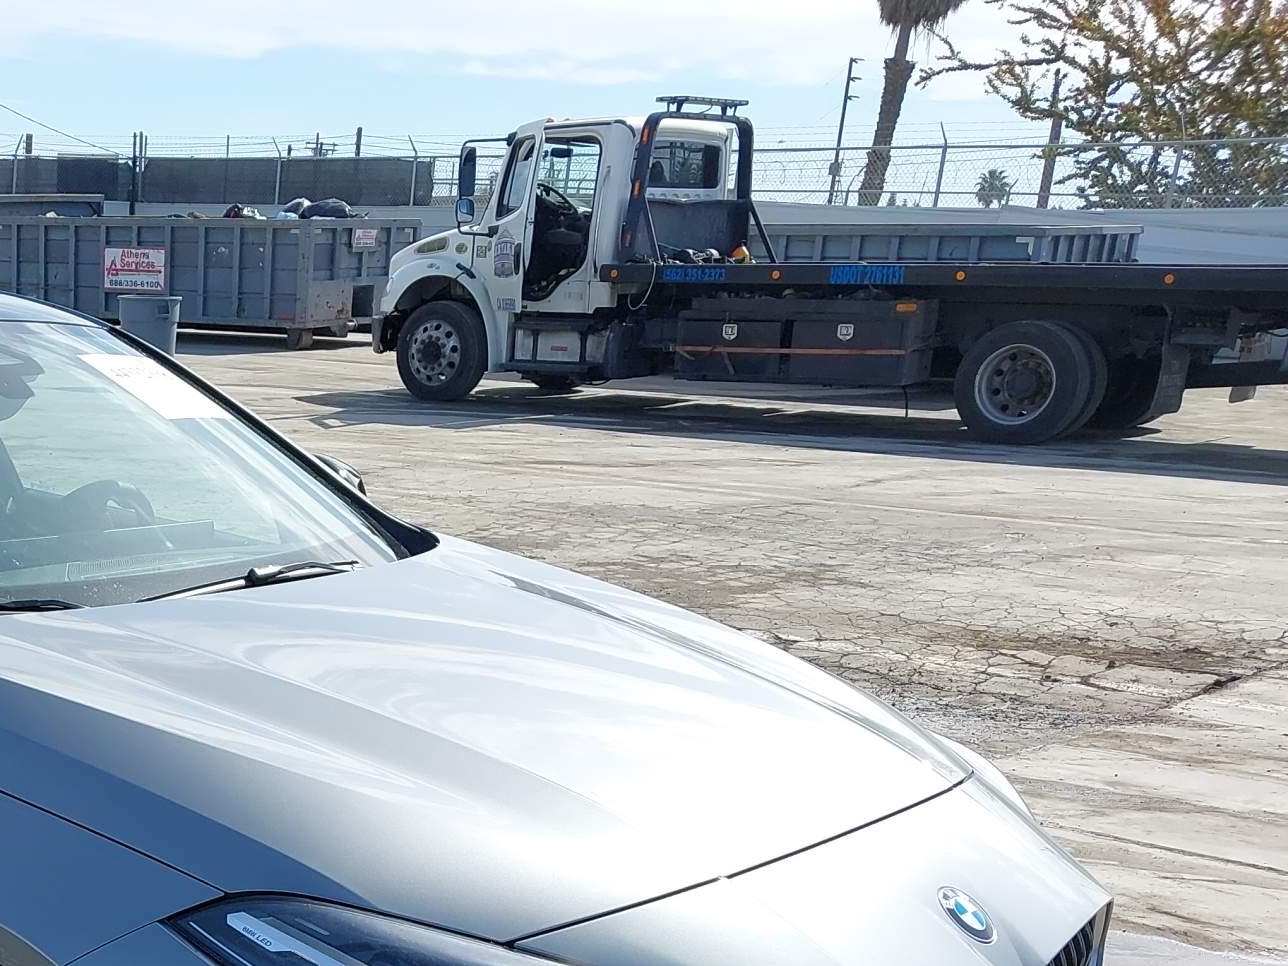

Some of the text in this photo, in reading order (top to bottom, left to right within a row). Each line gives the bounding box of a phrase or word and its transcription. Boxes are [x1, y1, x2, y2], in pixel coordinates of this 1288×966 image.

[120, 250, 150, 260] Athens
[119, 259, 156, 269] Services
[256, 934, 272, 947] LED
